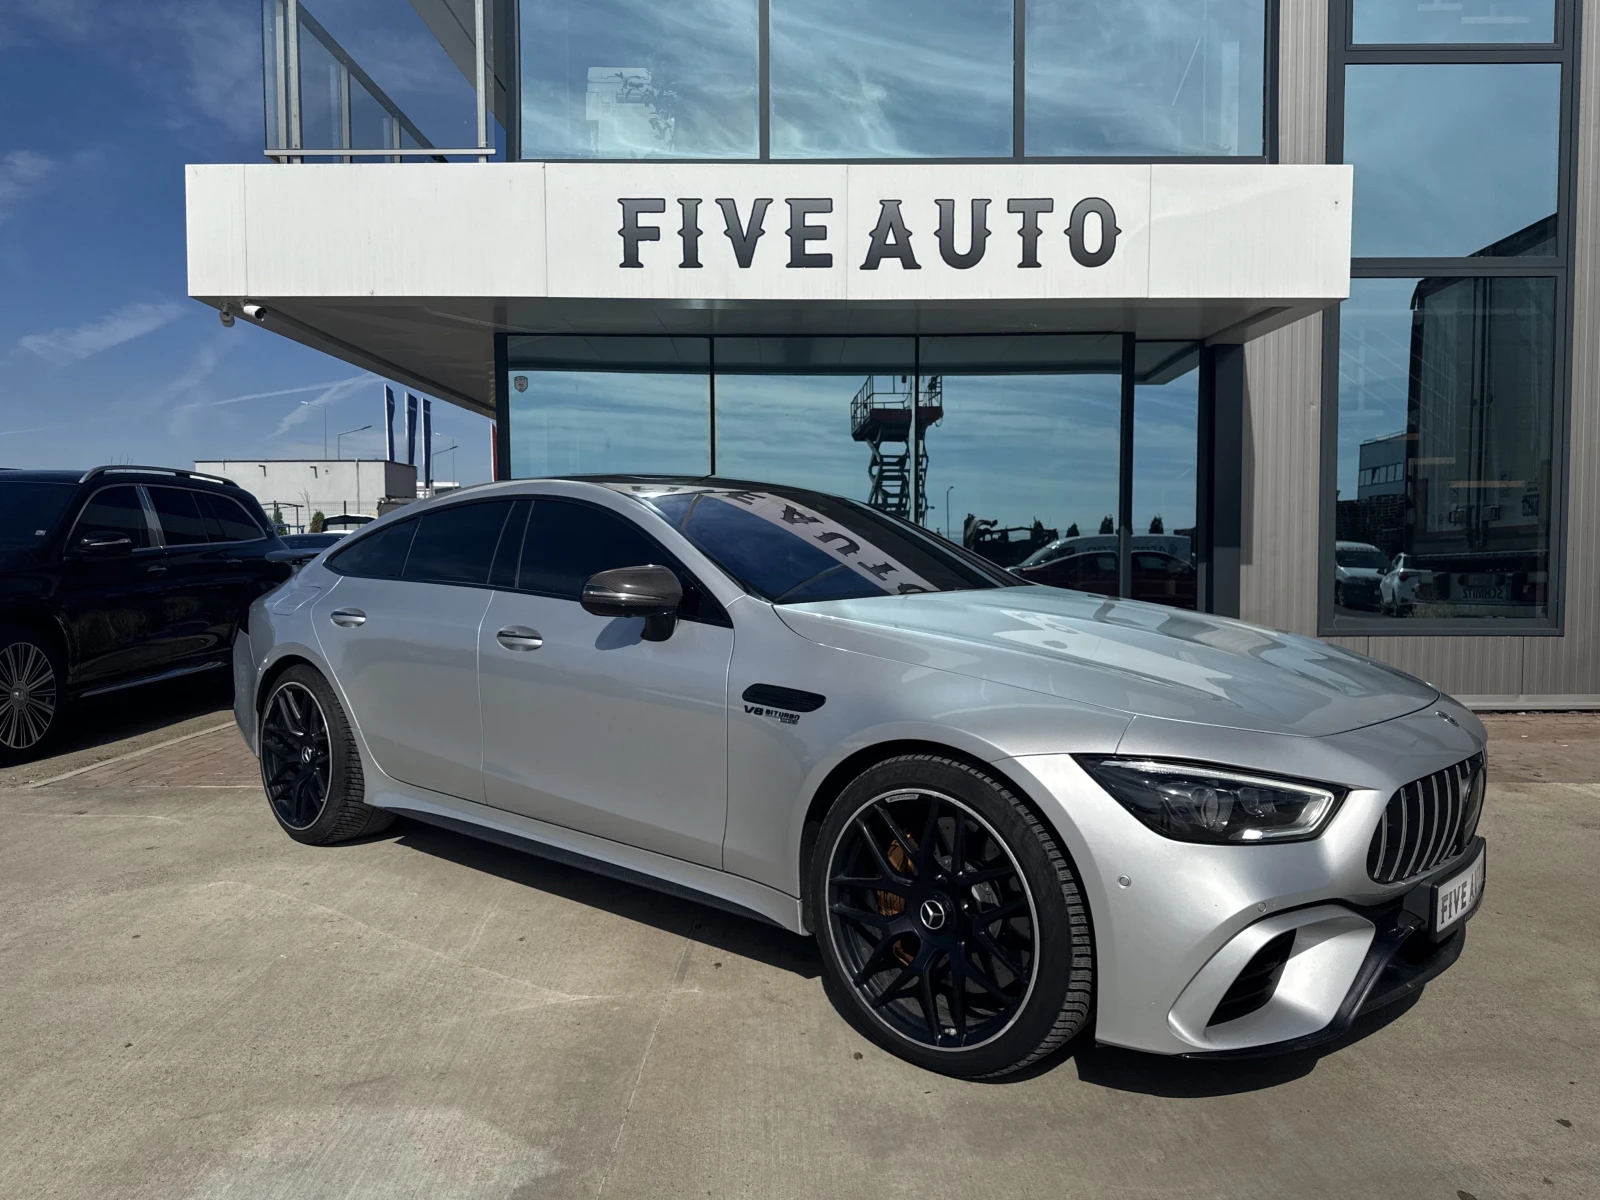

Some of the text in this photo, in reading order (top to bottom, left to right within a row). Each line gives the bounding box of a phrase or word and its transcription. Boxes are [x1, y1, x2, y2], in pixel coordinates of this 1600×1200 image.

[617, 196, 1122, 271] FIVE AUTO
[744, 704, 800, 721] V8 BITURBO
[1440, 880, 1468, 925] FIVE
